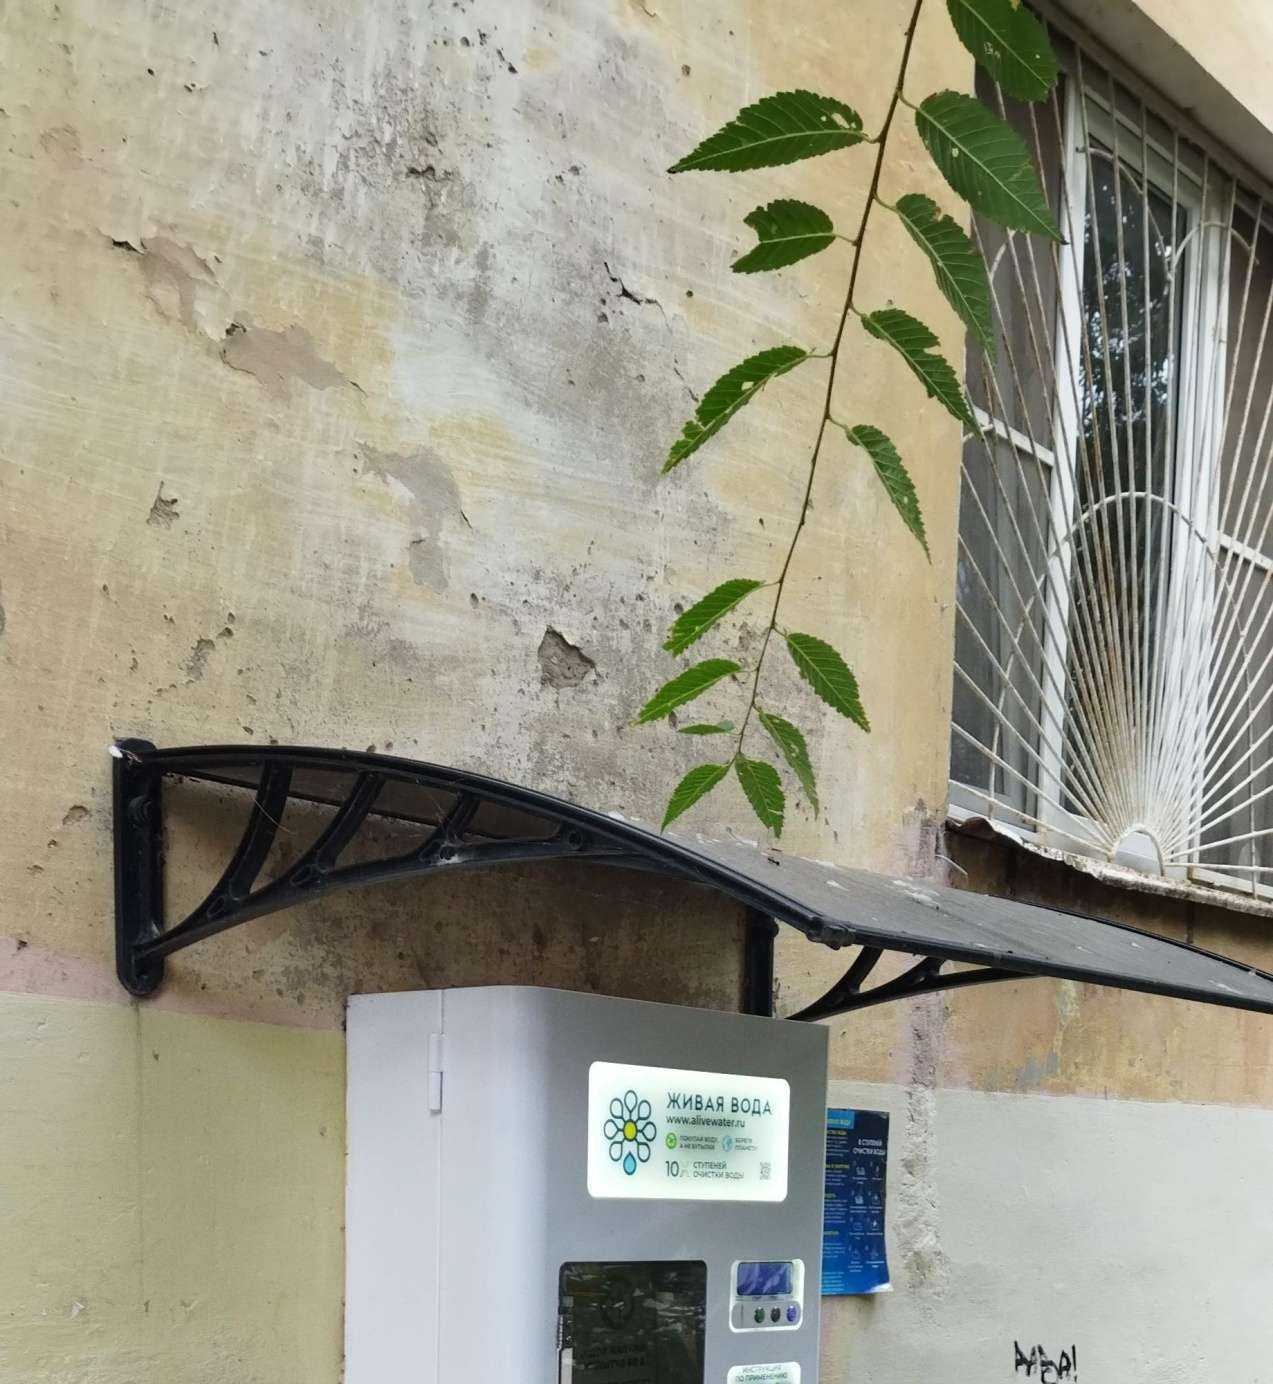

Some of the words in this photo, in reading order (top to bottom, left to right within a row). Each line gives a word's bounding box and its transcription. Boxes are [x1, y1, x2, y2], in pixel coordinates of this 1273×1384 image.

[667, 1092, 724, 1112] ЖИВАЯ
[731, 1097, 773, 1117] ВОДА
[666, 1115, 746, 1128] www.alivewater.ru
[665, 1160, 679, 1177] 10
[693, 1160, 727, 1170] СТУПЕНЕЙ
[693, 1170, 723, 1179] ОЧИСТКИ
